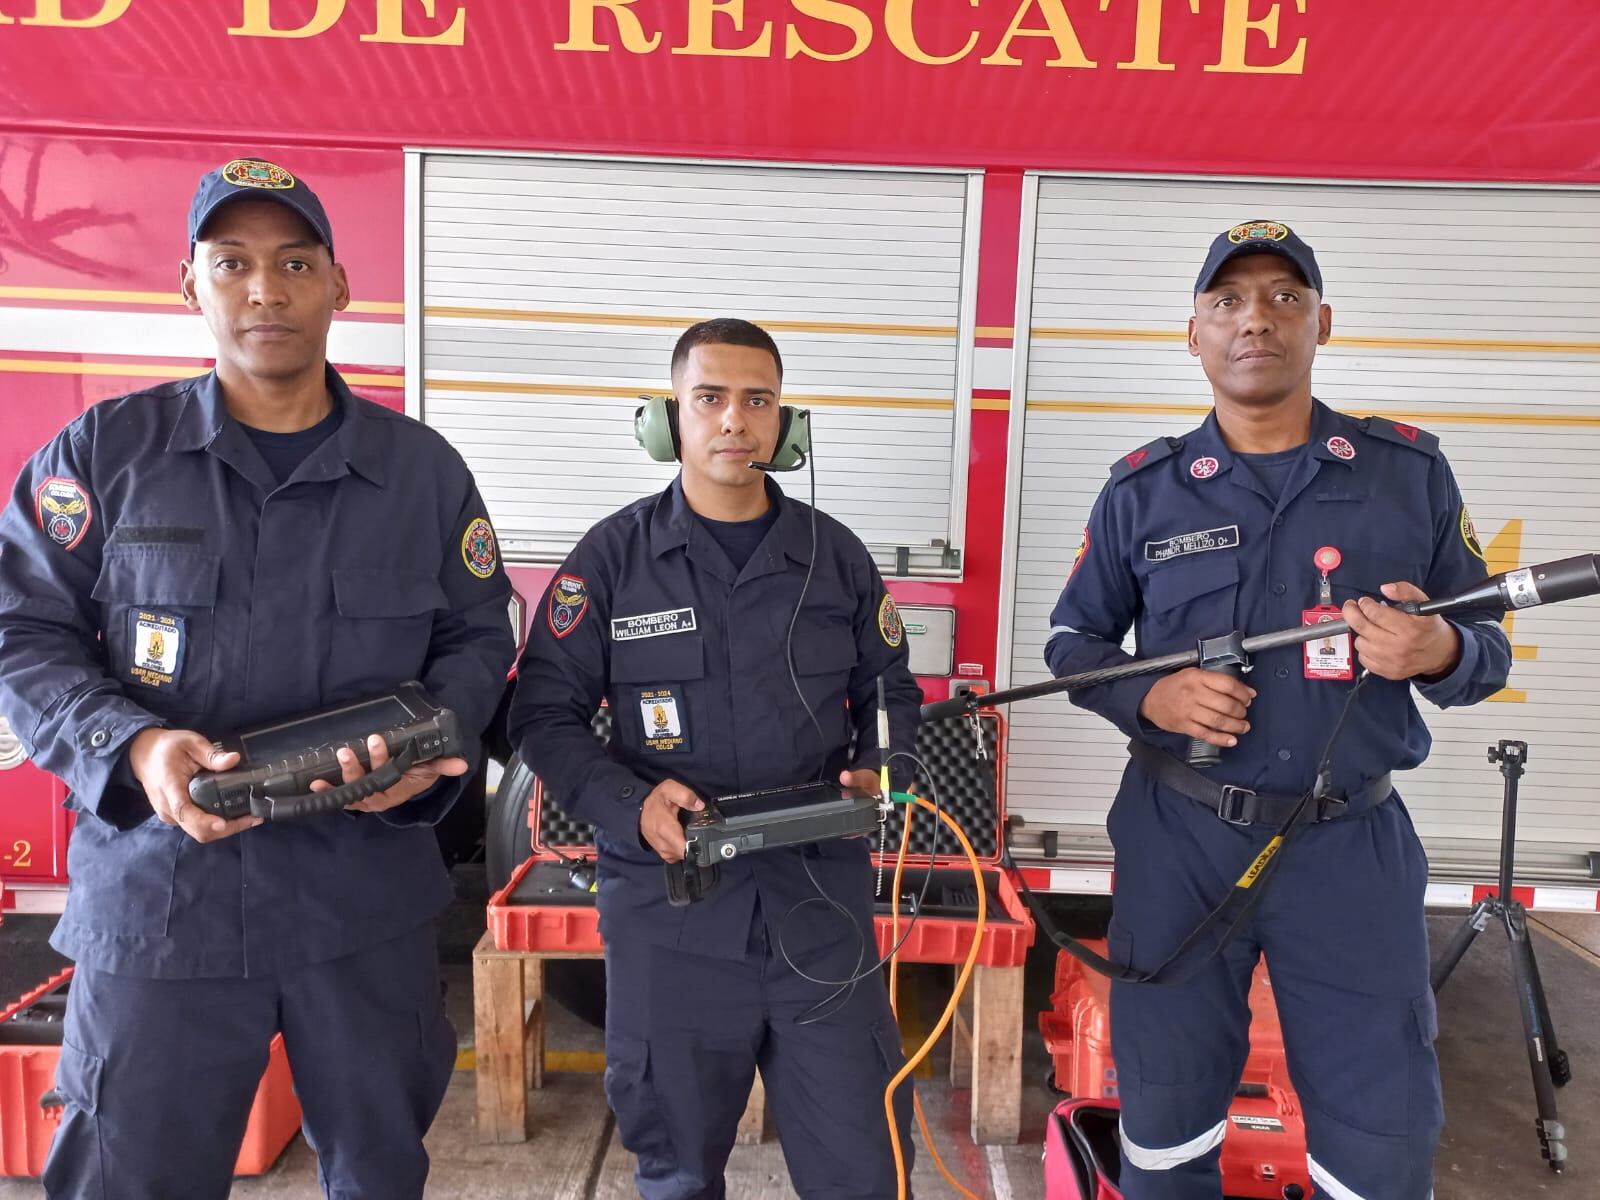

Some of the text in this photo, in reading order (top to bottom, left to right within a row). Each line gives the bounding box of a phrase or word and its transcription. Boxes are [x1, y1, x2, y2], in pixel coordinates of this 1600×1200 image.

[553, 0, 1308, 75] RESCATE
[1169, 532, 1210, 548] BOMBERO
[1183, 538, 1215, 552] MELLIZO
[139, 621, 177, 634] ACREDITADO
[627, 613, 679, 628] BOMBERO
[615, 625, 652, 638] WILLIAM
[654, 621, 678, 633] LEON
